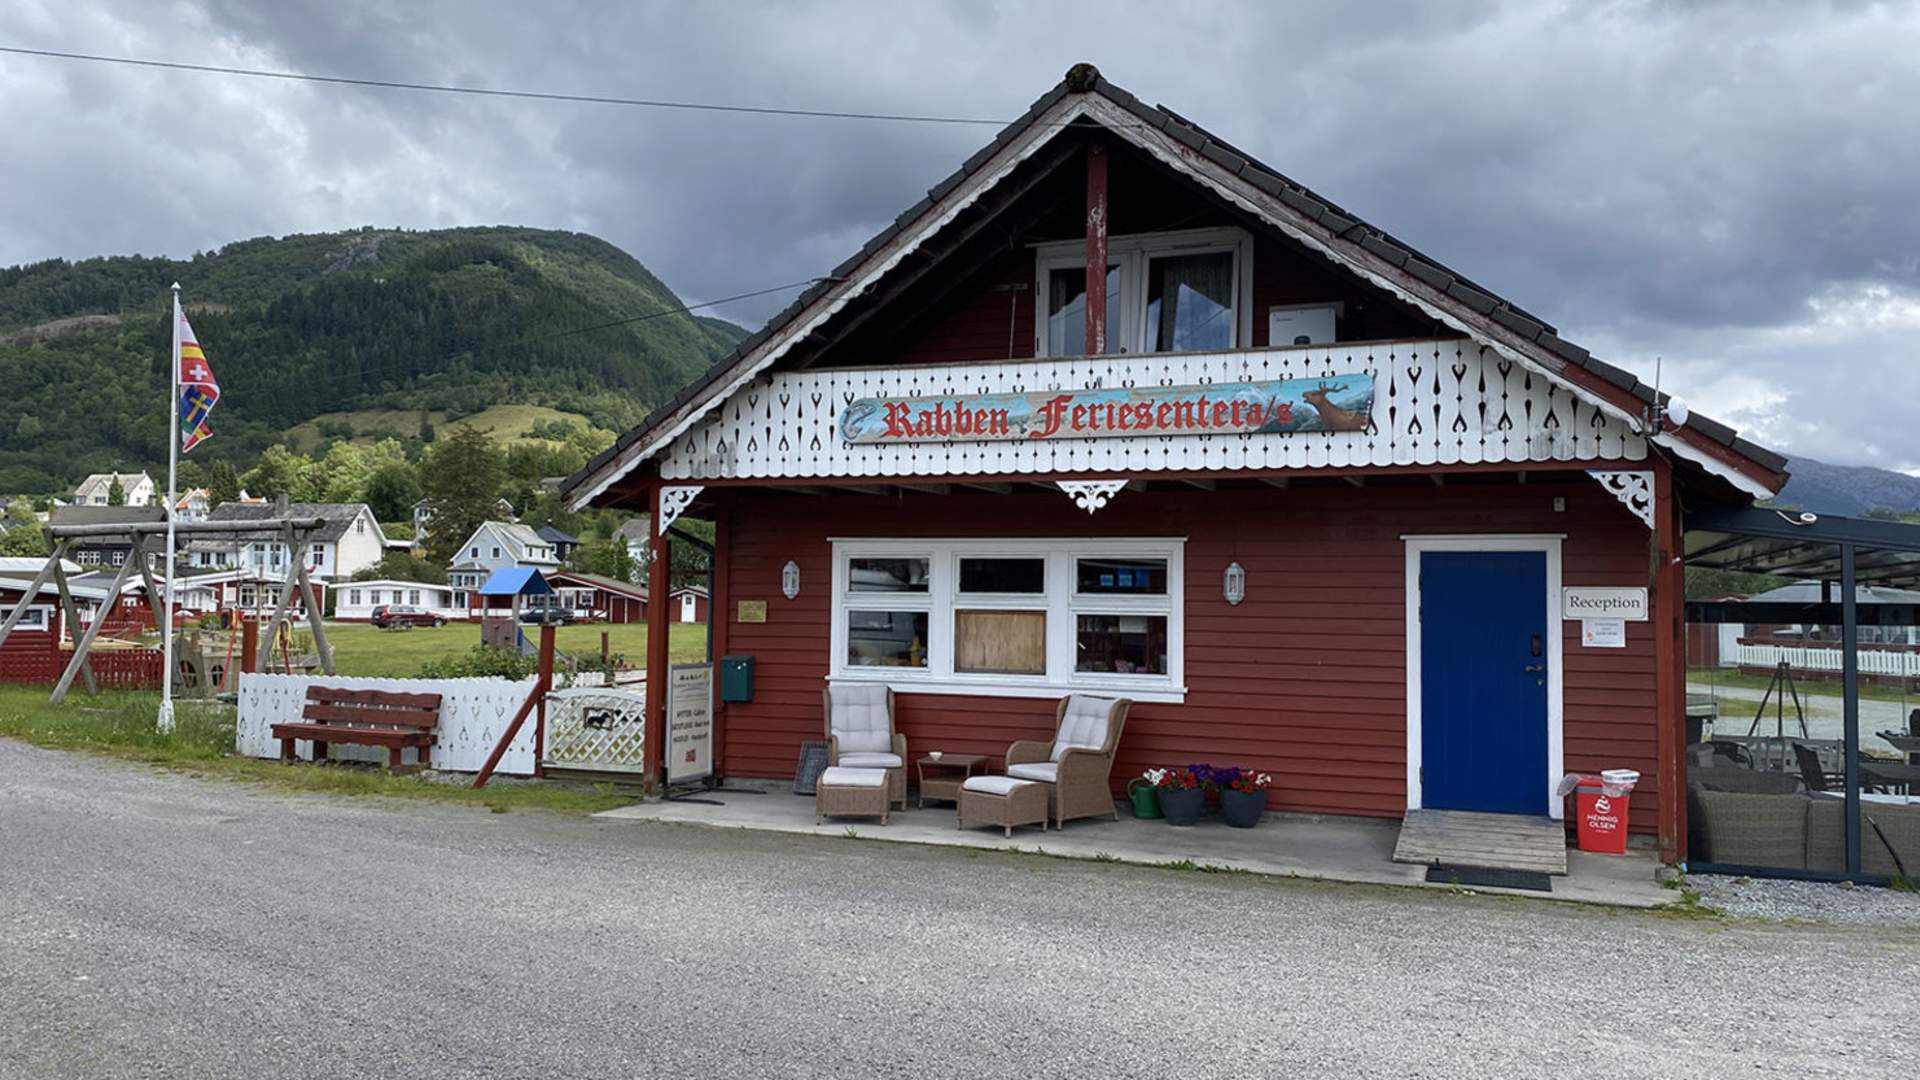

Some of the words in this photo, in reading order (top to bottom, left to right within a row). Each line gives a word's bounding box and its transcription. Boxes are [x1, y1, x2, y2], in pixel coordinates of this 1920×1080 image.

[880, 401, 1009, 438] Rabben
[1569, 595, 1640, 612] Reception
[1589, 821, 1616, 829] OLSEN
